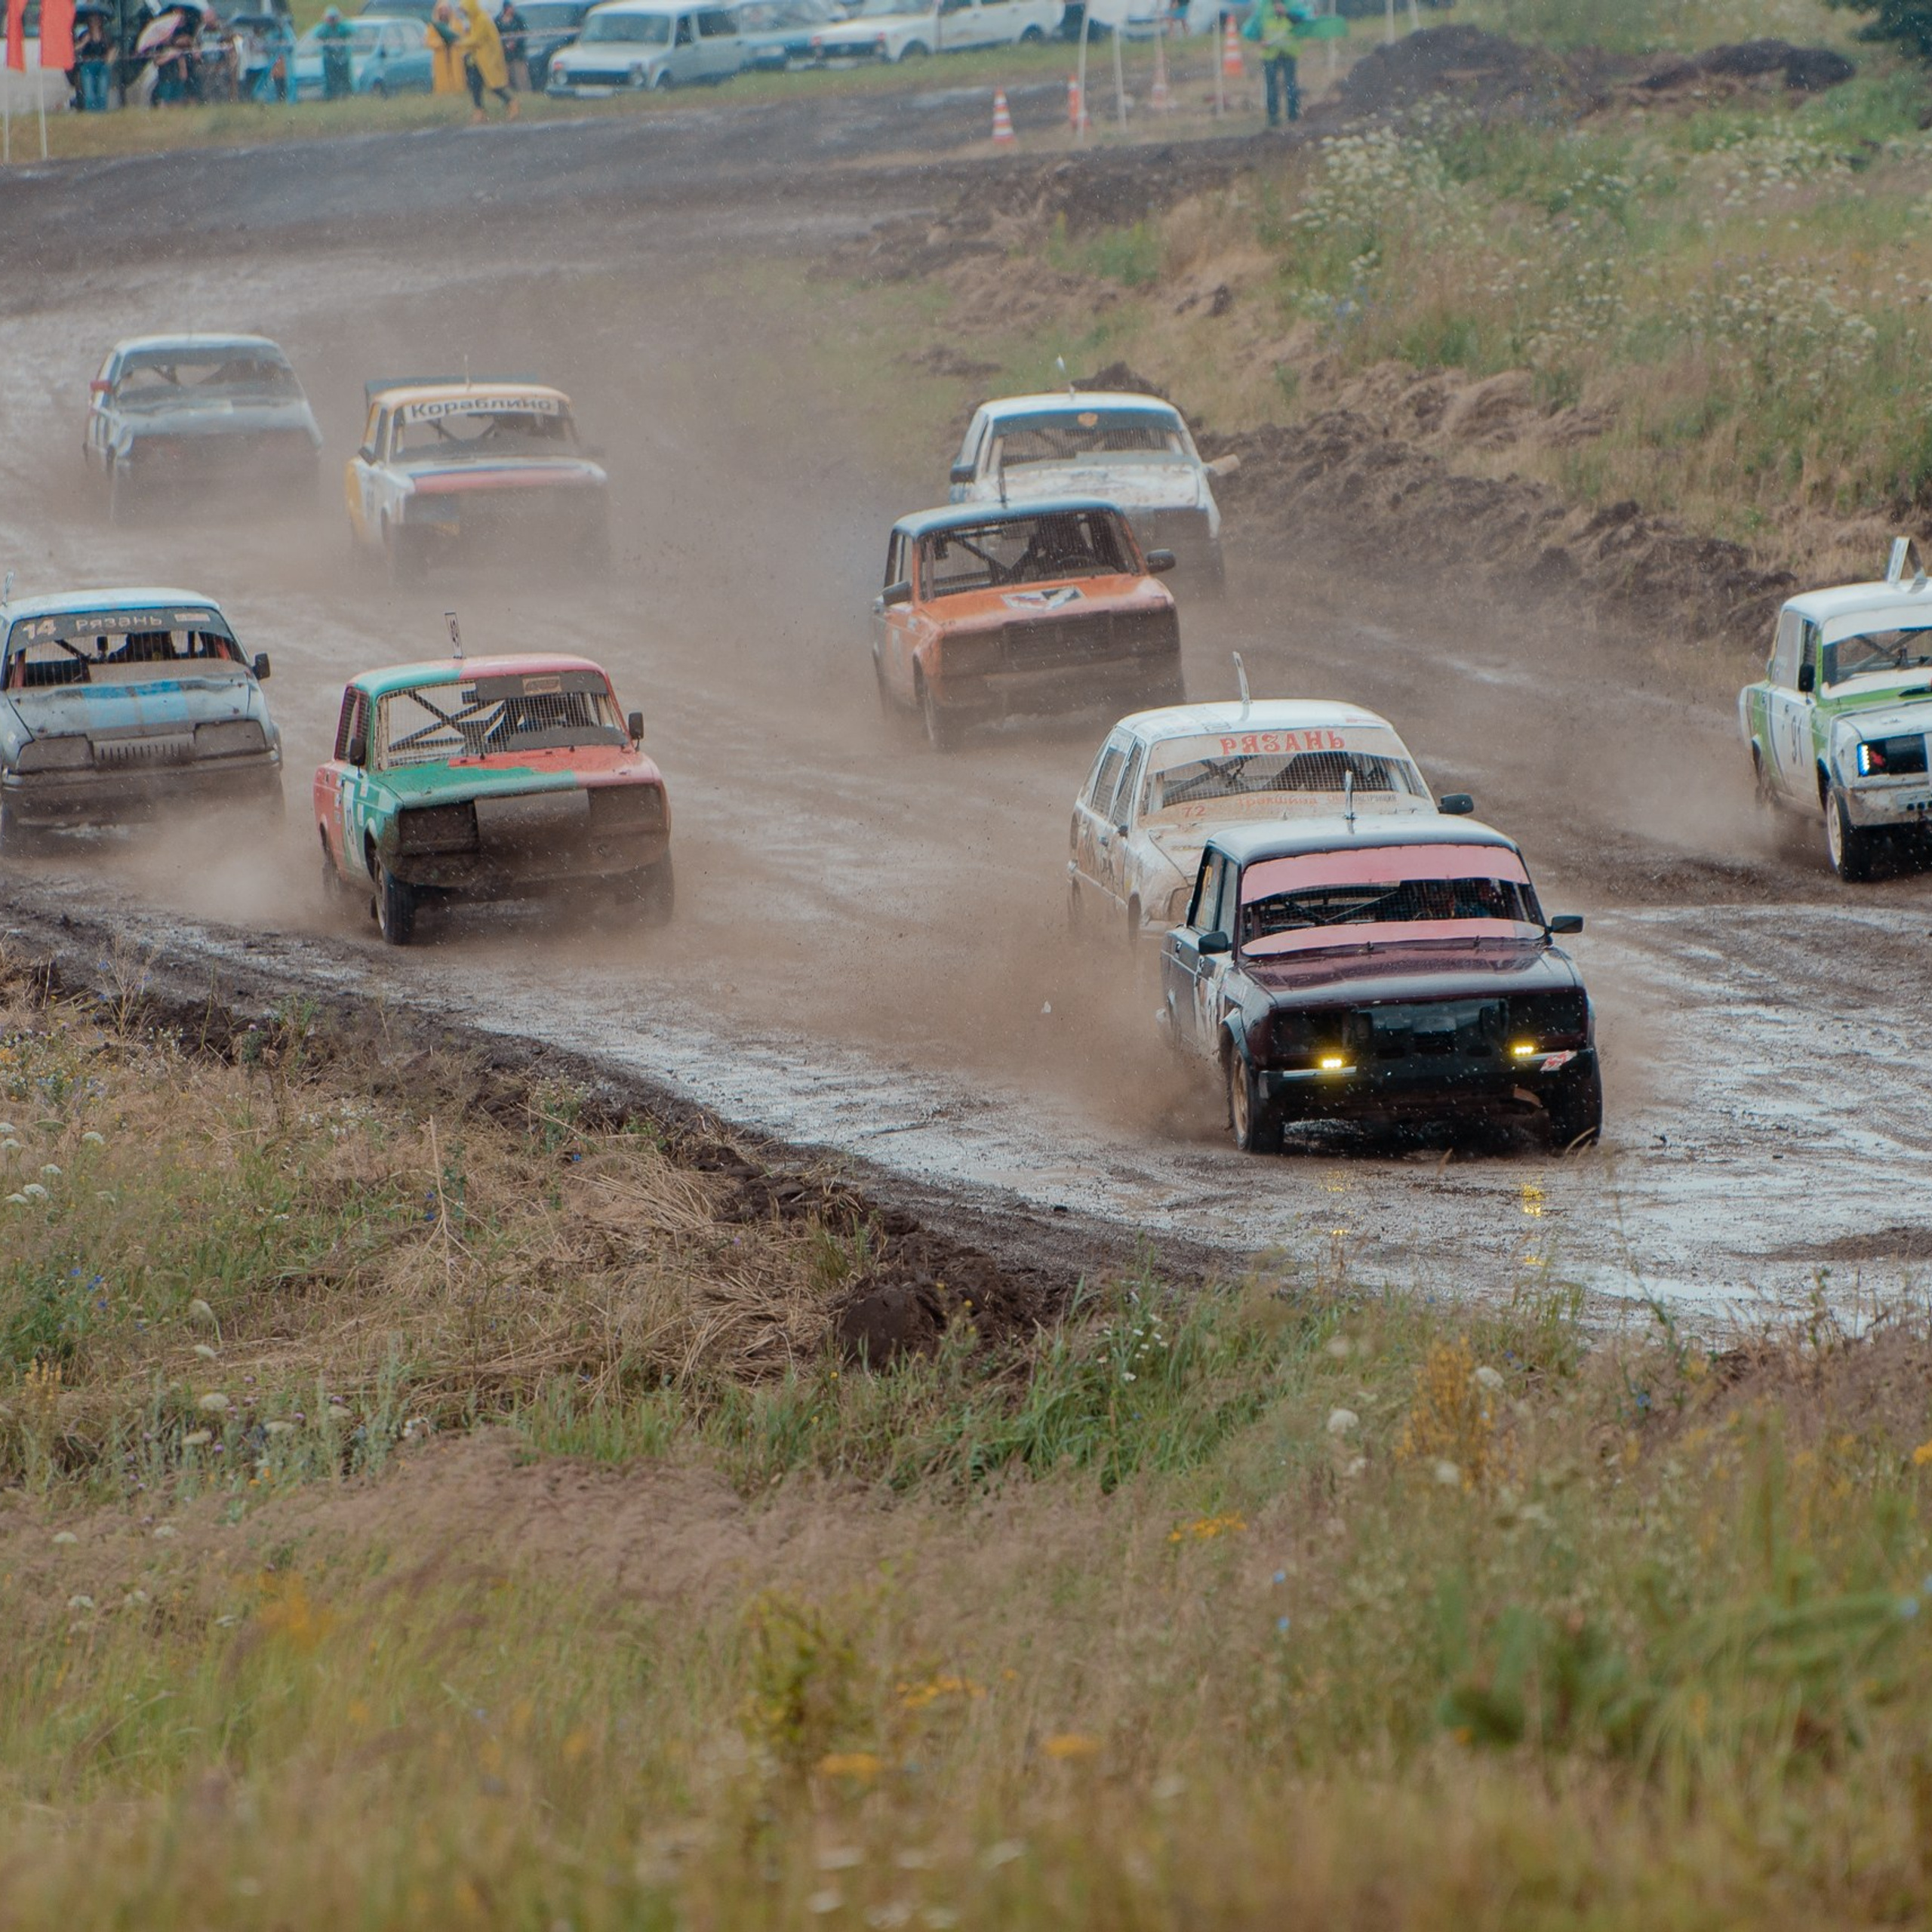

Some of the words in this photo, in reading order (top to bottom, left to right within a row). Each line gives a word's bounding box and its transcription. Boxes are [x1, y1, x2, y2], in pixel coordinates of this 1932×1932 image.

[412, 398, 552, 418] Кораблино
[23, 619, 57, 640] 14
[1220, 730, 1345, 755] РЯЗАНЬ
[1791, 715, 1804, 767] 91
[1183, 805, 1206, 817] 72
